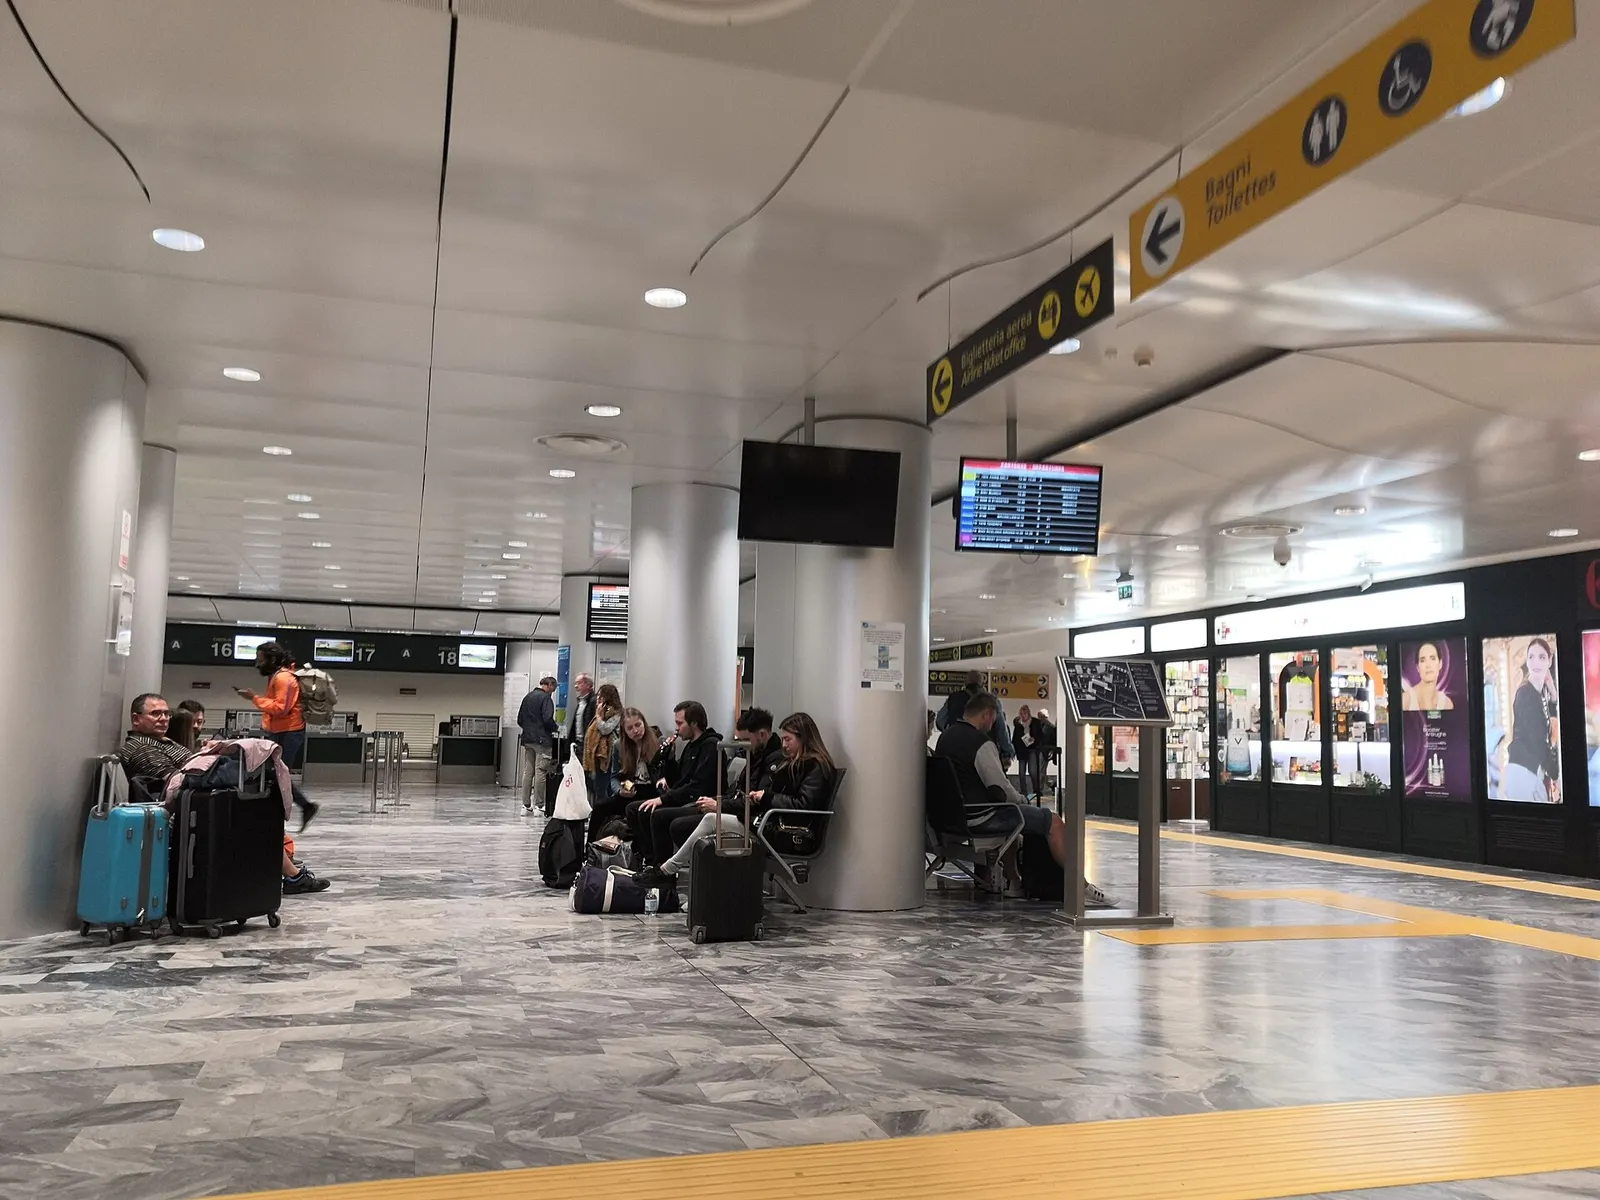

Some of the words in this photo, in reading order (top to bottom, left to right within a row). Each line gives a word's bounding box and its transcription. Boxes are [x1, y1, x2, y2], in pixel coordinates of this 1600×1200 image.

[1206, 154, 1251, 203] Bagni
[1207, 171, 1277, 229] Toilettes
[961, 325, 1005, 369] Biglietteria
[1006, 310, 1033, 341] aerea
[961, 361, 983, 389] Airline
[983, 346, 1004, 375] ticket
[1004, 334, 1027, 361] office
[172, 641, 180, 649] A
[211, 642, 232, 657] 16
[356, 648, 376, 662] 17
[402, 650, 410, 658] A
[438, 651, 457, 665] 18
